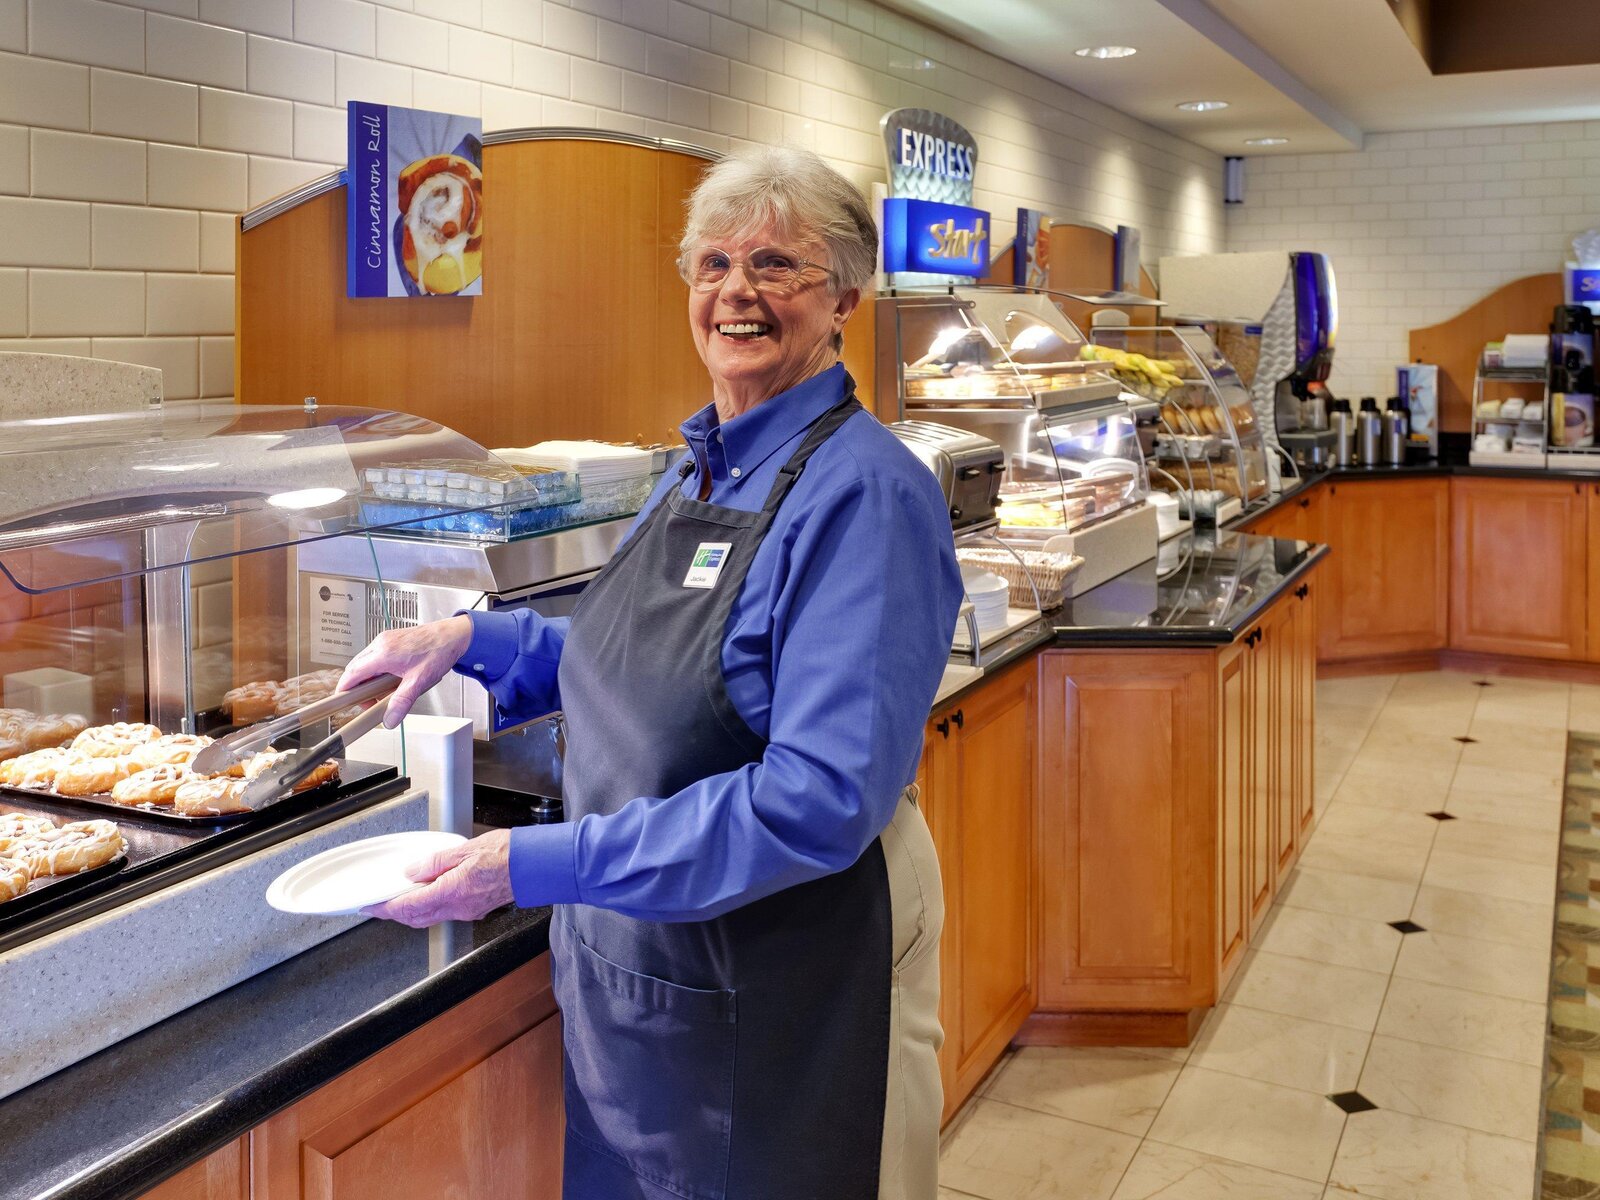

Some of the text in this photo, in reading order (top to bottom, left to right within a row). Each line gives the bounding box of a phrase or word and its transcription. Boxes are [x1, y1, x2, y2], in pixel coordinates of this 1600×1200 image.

[901, 127, 974, 181] EXPRESS
[362, 115, 381, 269] Cinnamon Roll
[927, 218, 988, 265] Start
